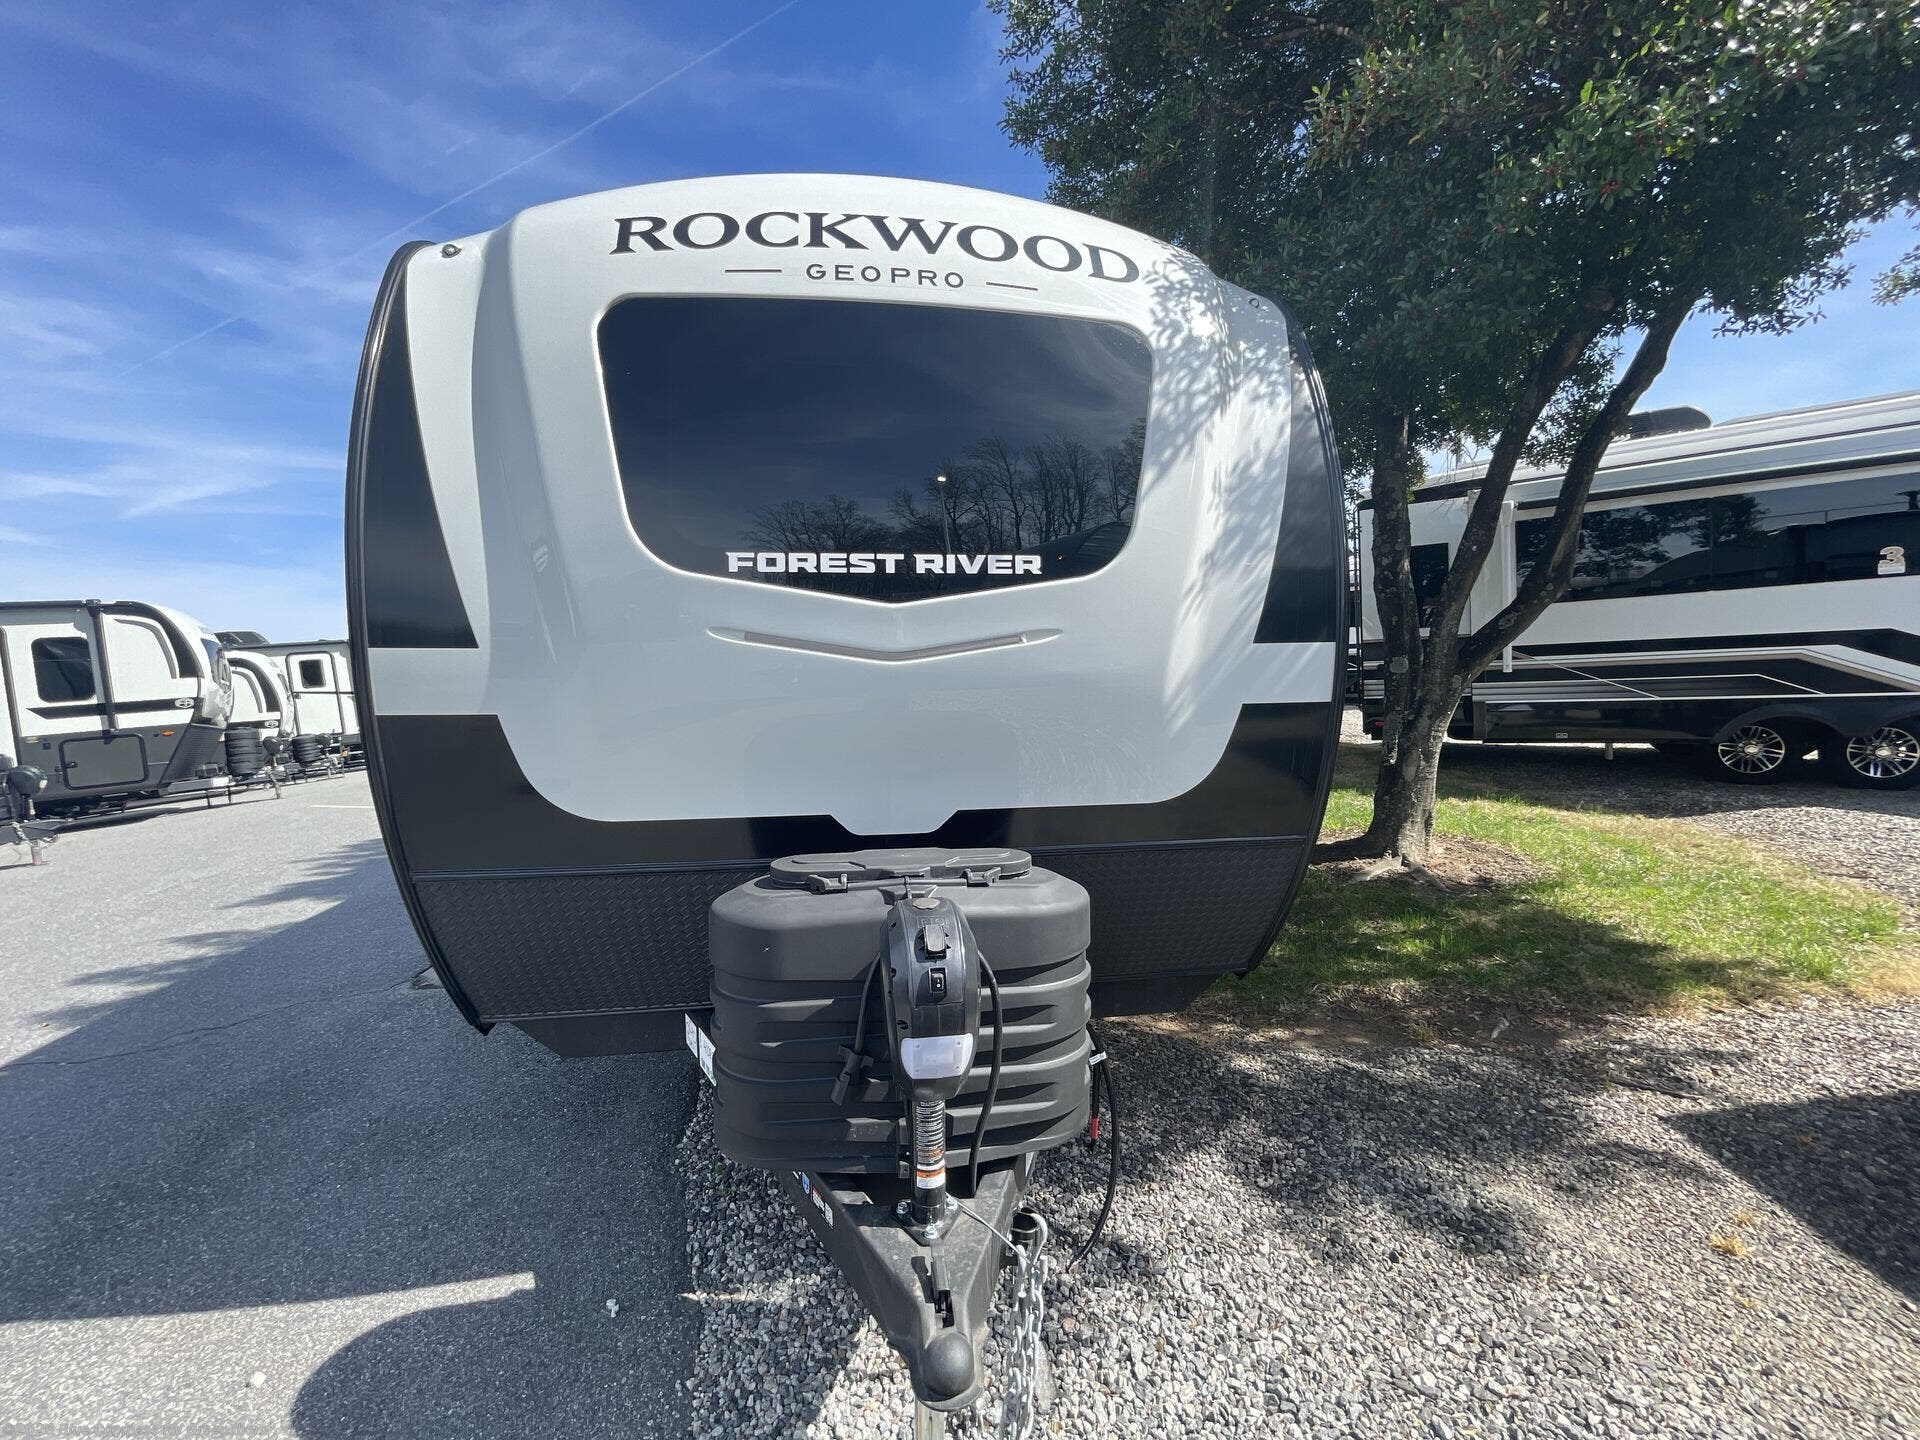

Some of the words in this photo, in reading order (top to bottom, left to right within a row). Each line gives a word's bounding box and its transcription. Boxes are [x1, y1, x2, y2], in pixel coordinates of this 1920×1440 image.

[609, 211, 1140, 284] ROCKWOOD
[805, 262, 965, 289] GEOPRO
[725, 551, 905, 574] FOREST
[912, 553, 1043, 575] RIVER
